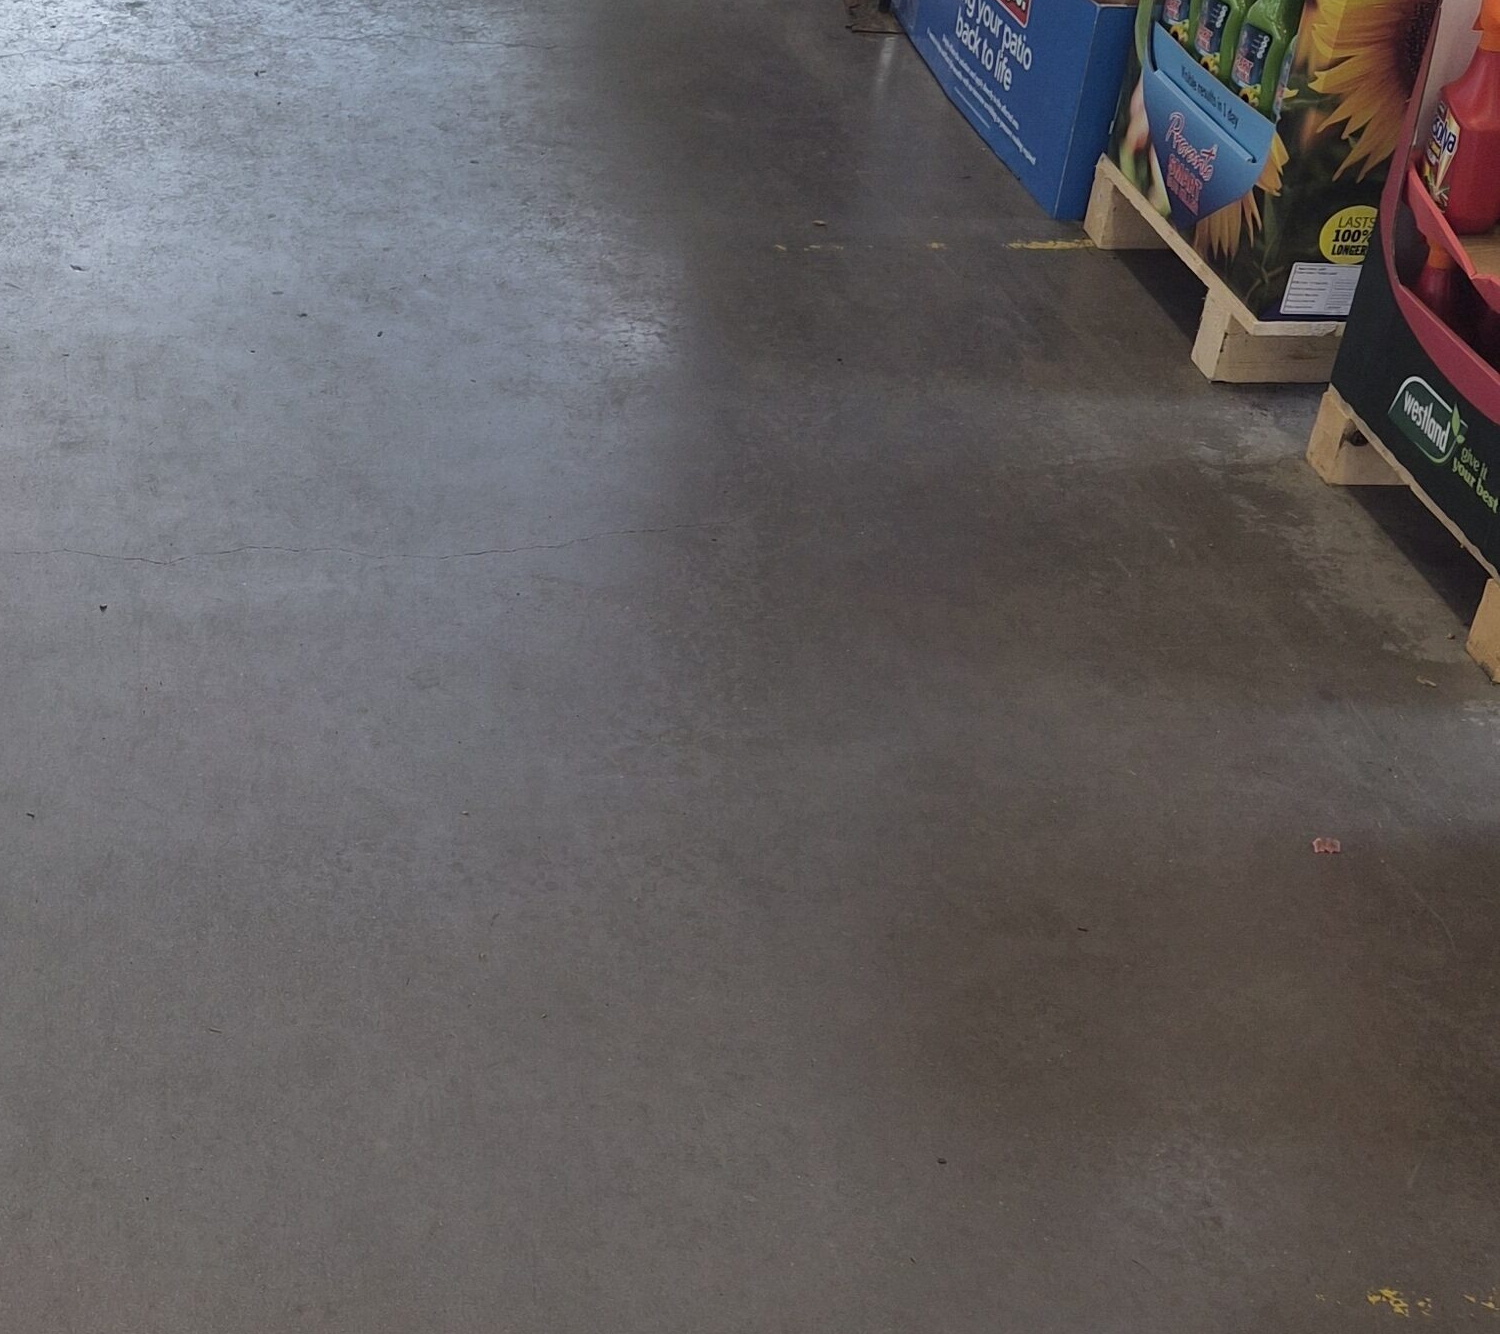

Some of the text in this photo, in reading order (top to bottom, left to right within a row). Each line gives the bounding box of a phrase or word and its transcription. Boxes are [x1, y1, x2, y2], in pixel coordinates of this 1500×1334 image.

[955, 5, 1013, 91] back to life
[1001, 24, 1032, 71] patio
[1332, 229, 1374, 244] 100%
[1338, 216, 1377, 228] LASTS
[1330, 244, 1369, 256] LONGER
[1403, 390, 1451, 454] westland
[1460, 447, 1488, 481] give it
[1452, 457, 1499, 514] your best
